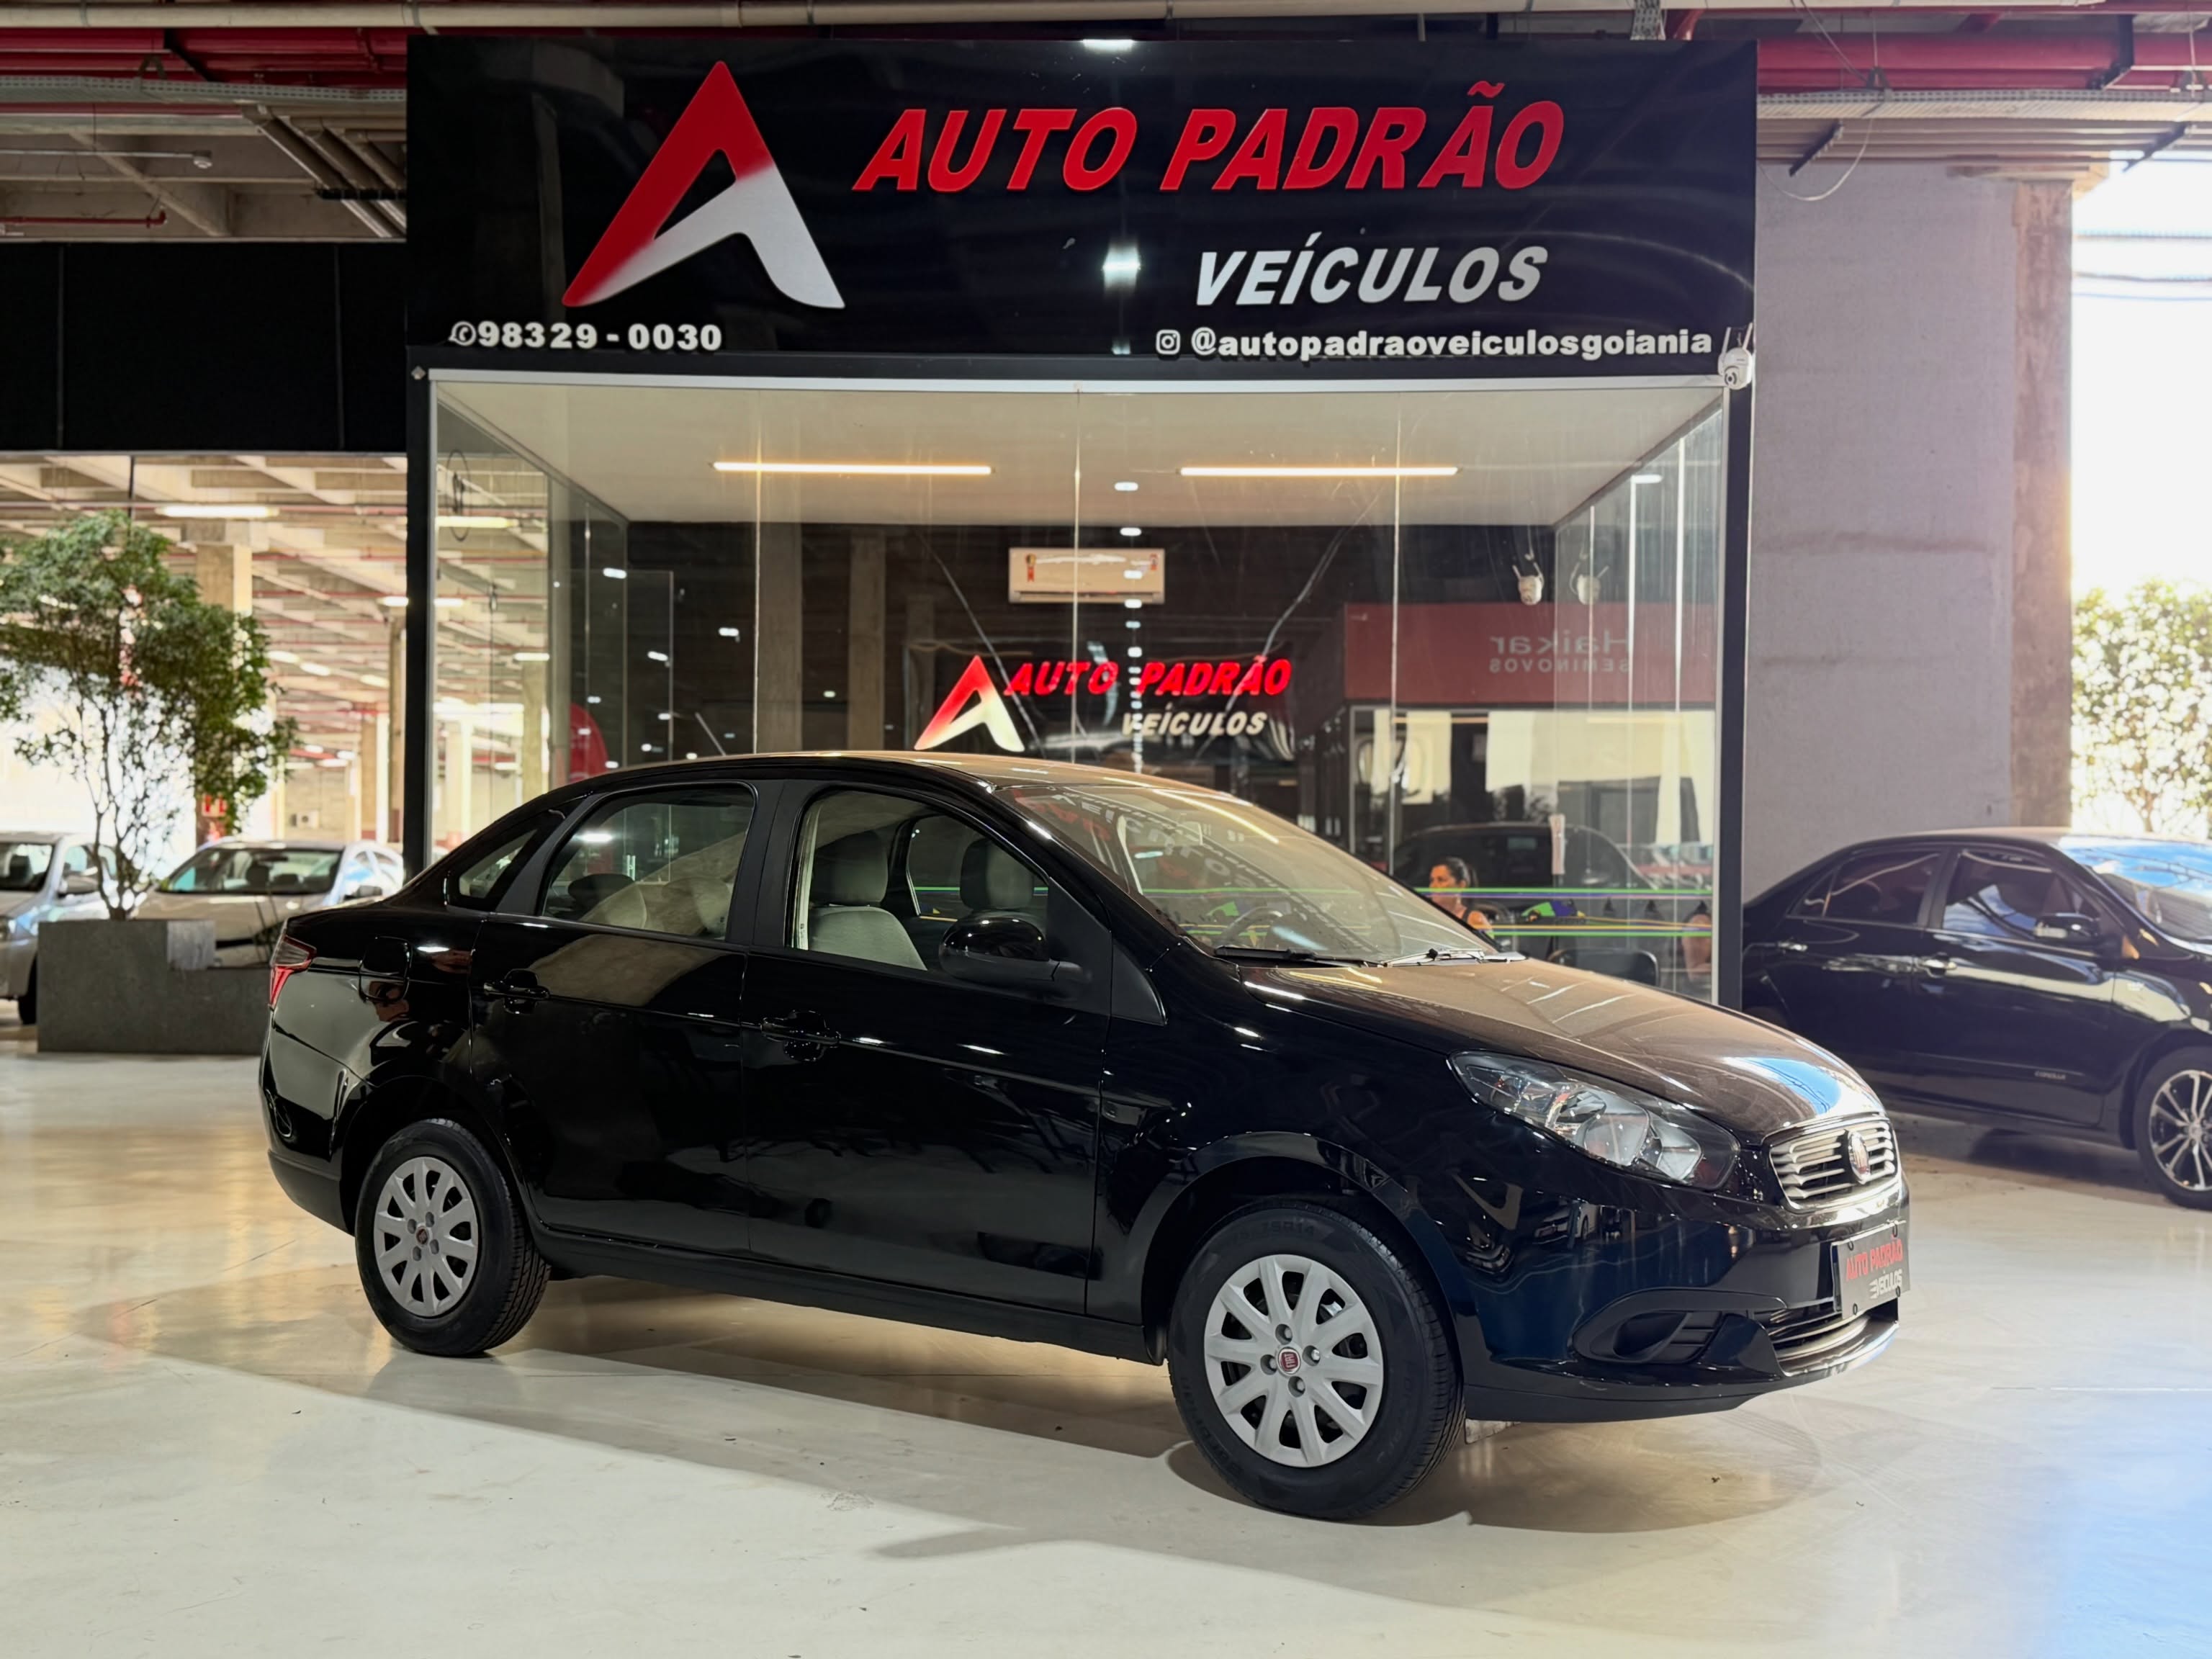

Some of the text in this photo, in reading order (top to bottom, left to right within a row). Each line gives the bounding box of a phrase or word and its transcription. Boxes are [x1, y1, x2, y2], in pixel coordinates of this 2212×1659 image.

[853, 81, 1564, 192] AUTO PADRÃO
[1196, 232, 1548, 306] VEÍCULOS
[1191, 327, 1712, 361] @autopadraoveiculosgoiania
[1004, 655, 1292, 696] AUTO PADRÃO
[1121, 701, 1267, 736] VEÍCULOS
[1845, 1252, 1869, 1282] AUTO
